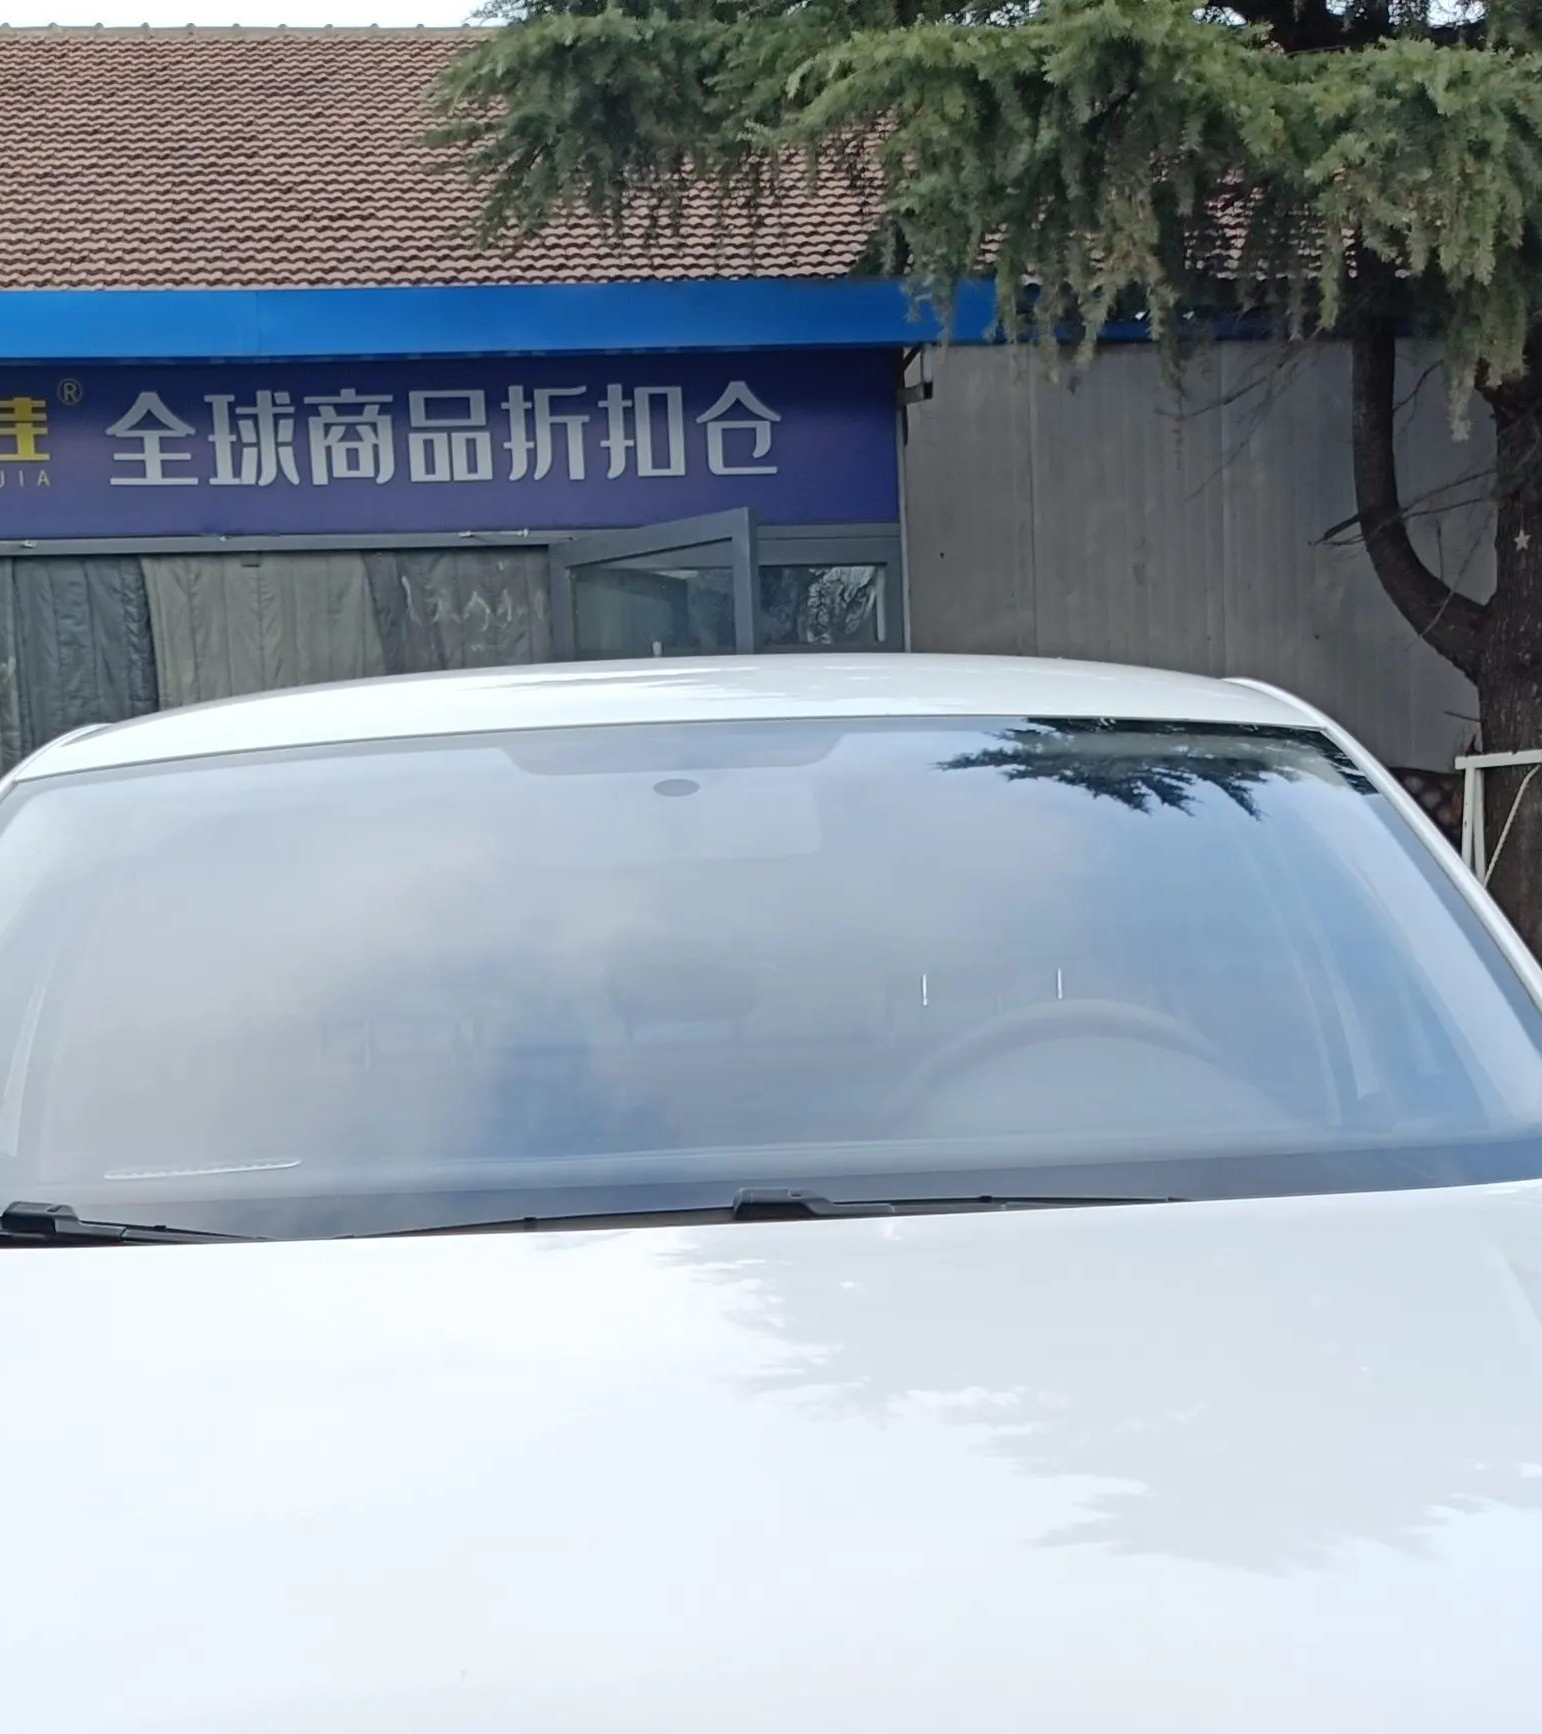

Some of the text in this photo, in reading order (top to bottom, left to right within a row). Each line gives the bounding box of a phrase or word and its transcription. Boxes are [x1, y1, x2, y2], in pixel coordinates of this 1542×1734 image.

[105, 380, 782, 487] 全球商品折扣仓
